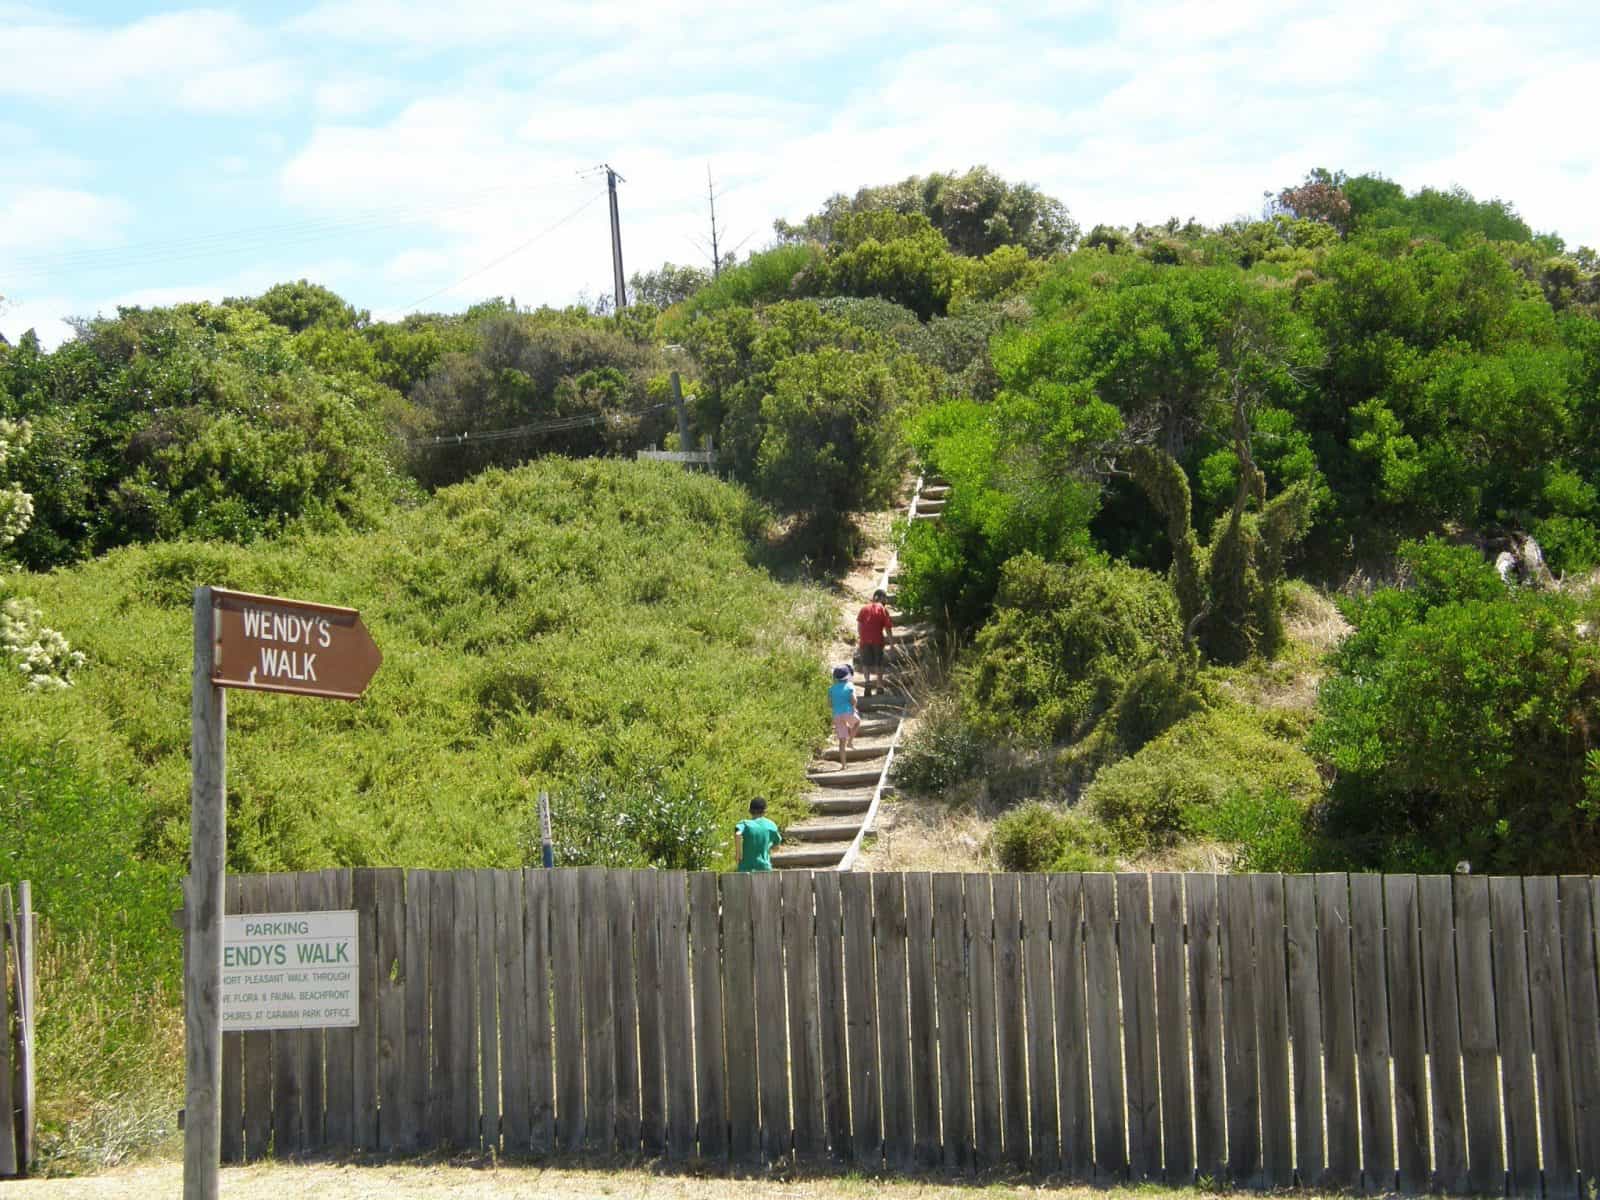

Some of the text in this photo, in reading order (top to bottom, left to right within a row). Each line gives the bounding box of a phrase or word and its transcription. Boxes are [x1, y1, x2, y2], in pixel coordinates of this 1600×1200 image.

[243, 608, 332, 648] WENDY'S
[261, 647, 317, 681] WALK
[246, 921, 309, 936] PARKING
[223, 942, 349, 967] ENDYS WALK
[245, 974, 284, 985] PLEASANT
[287, 973, 308, 983] WALK
[312, 972, 351, 982] THROUGH
[234, 993, 258, 1002] FLORA
[299, 990, 350, 1000] BEACHFRONT
[302, 1009, 321, 1018] PARK
[324, 1008, 351, 1018] OFFICE
